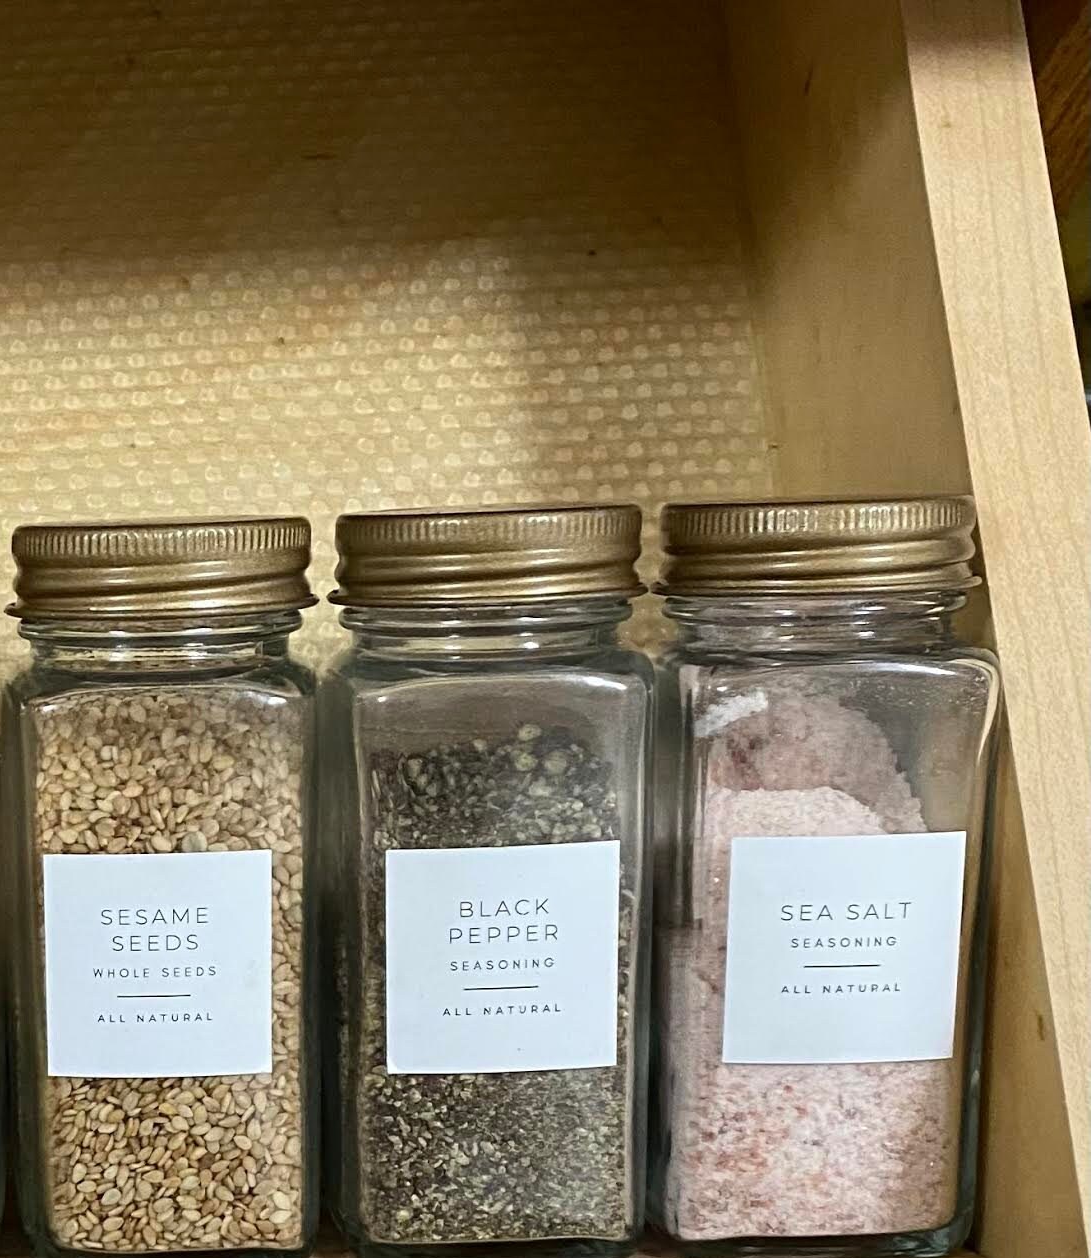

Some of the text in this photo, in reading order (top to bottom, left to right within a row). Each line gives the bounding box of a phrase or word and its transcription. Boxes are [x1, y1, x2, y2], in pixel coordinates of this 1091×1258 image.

[459, 898, 550, 919] BLACK
[780, 902, 913, 921] SEA SALT
[100, 907, 210, 927] SESAME
[449, 924, 558, 944] PEPPER
[111, 934, 199, 952] SEEDS
[790, 936, 897, 949] SEASONING
[450, 957, 555, 971] SEASONING
[92, 966, 217, 978] WHOLE SEEDS
[781, 983, 901, 994] ALL NATURAL
[442, 1003, 561, 1016] ALL NATURAL
[97, 1012, 214, 1023] ALL NATURAL
